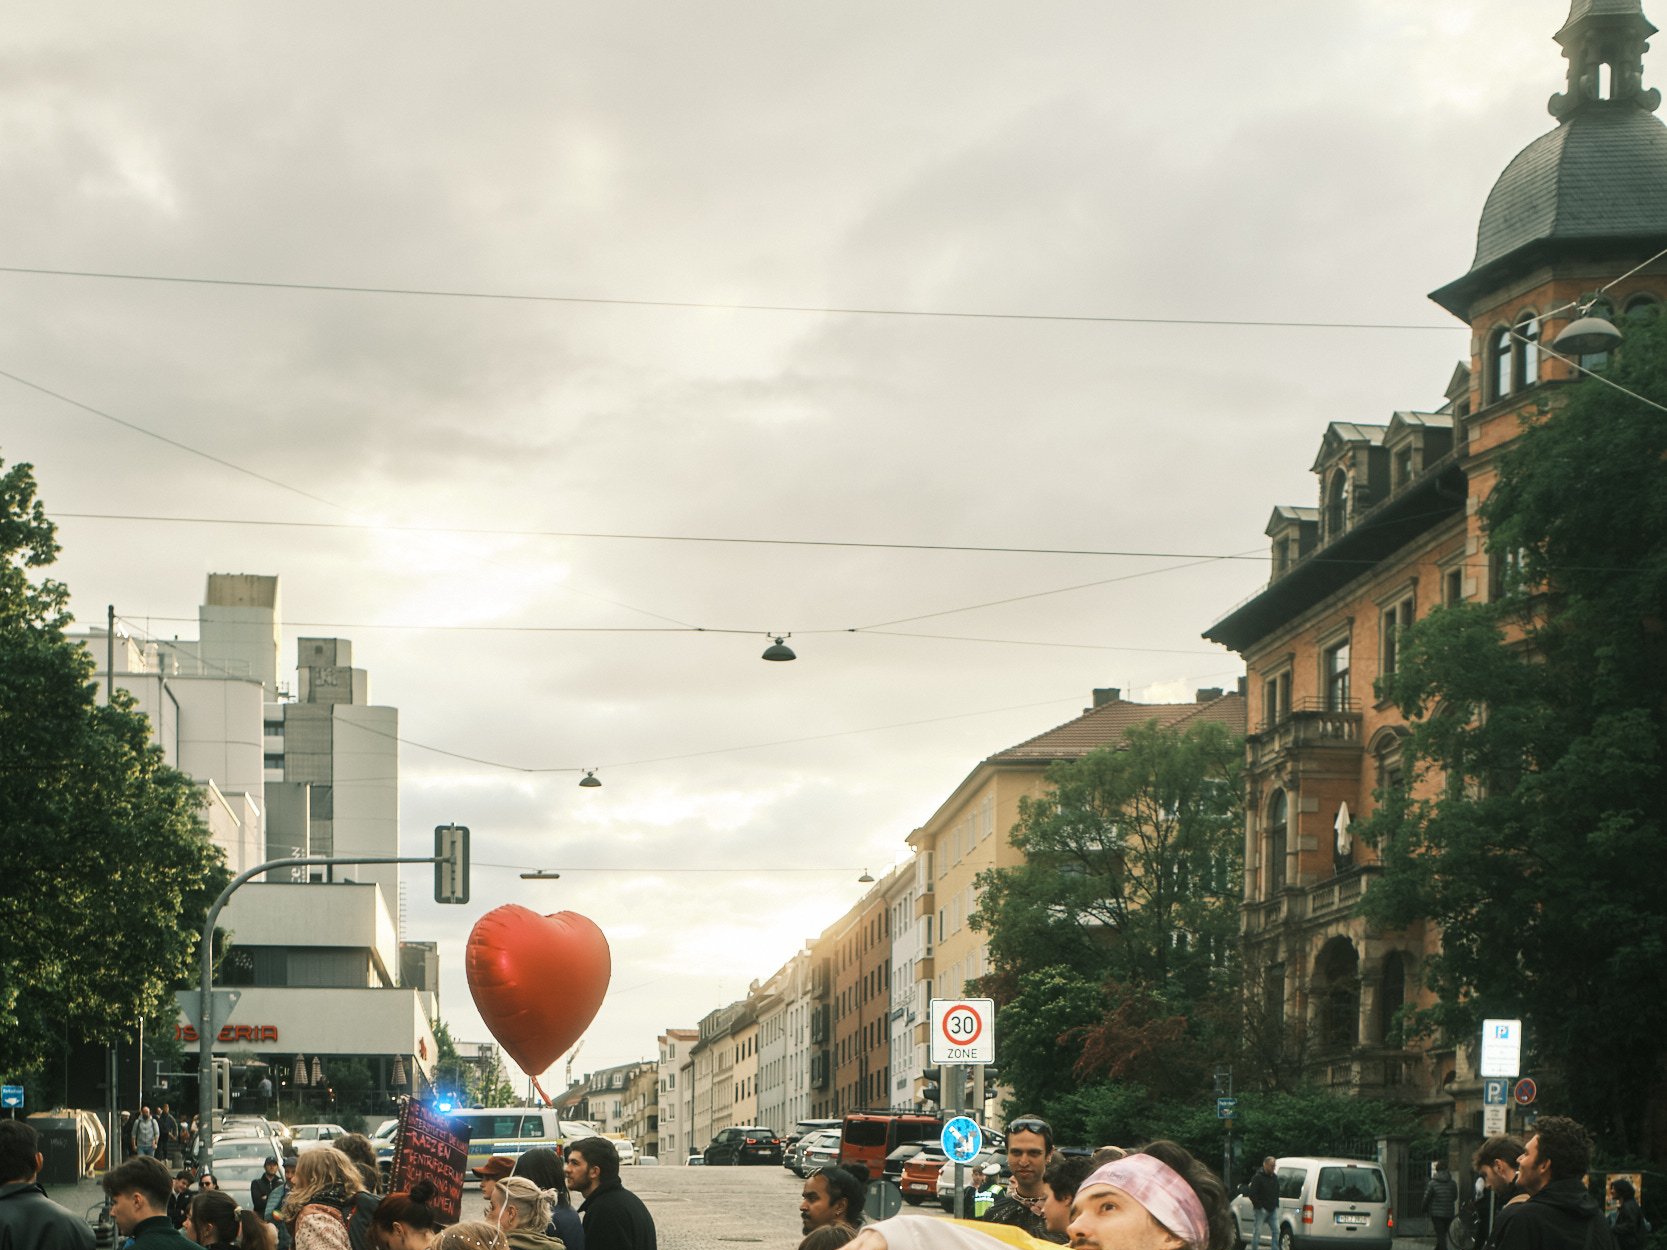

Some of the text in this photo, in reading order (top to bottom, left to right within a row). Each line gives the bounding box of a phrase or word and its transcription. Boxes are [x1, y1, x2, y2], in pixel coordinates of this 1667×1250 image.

[174, 1024, 278, 1041] SERIA
[951, 1016, 974, 1034] 30
[947, 1049, 978, 1059] ZONE
[1488, 1083, 1501, 1102] P
